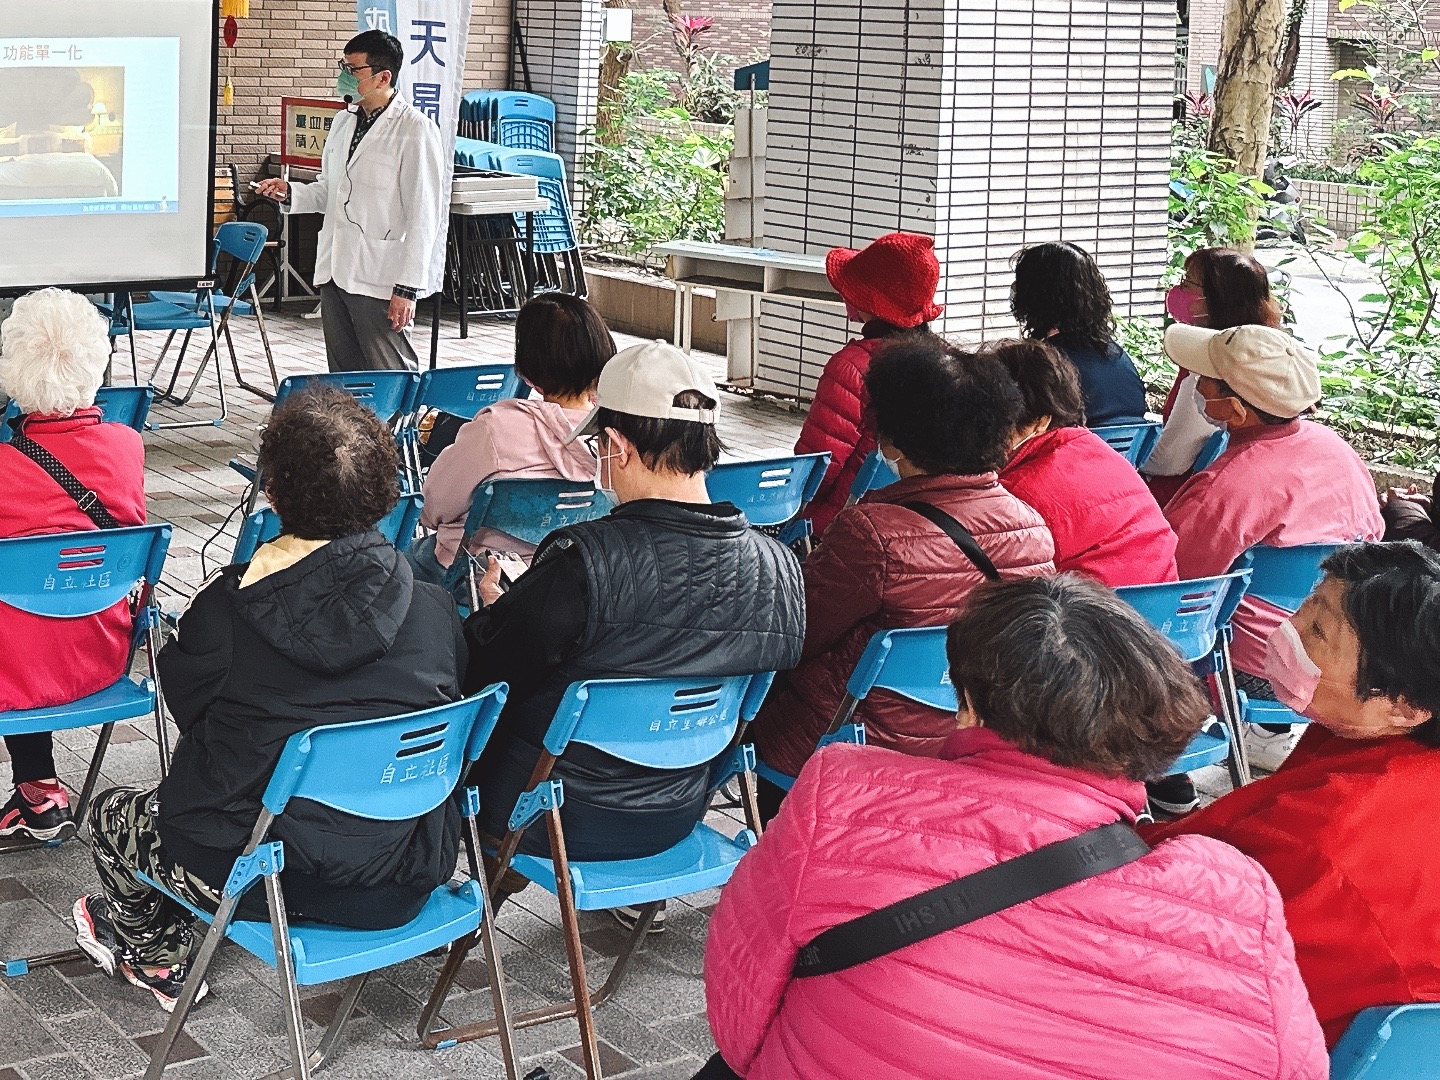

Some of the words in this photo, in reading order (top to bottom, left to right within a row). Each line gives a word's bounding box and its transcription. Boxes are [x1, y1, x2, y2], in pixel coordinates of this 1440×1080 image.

[3, 44, 83, 61] 功能單一化
[295, 133, 327, 151] 請入
[380, 752, 451, 784] 自立社區
